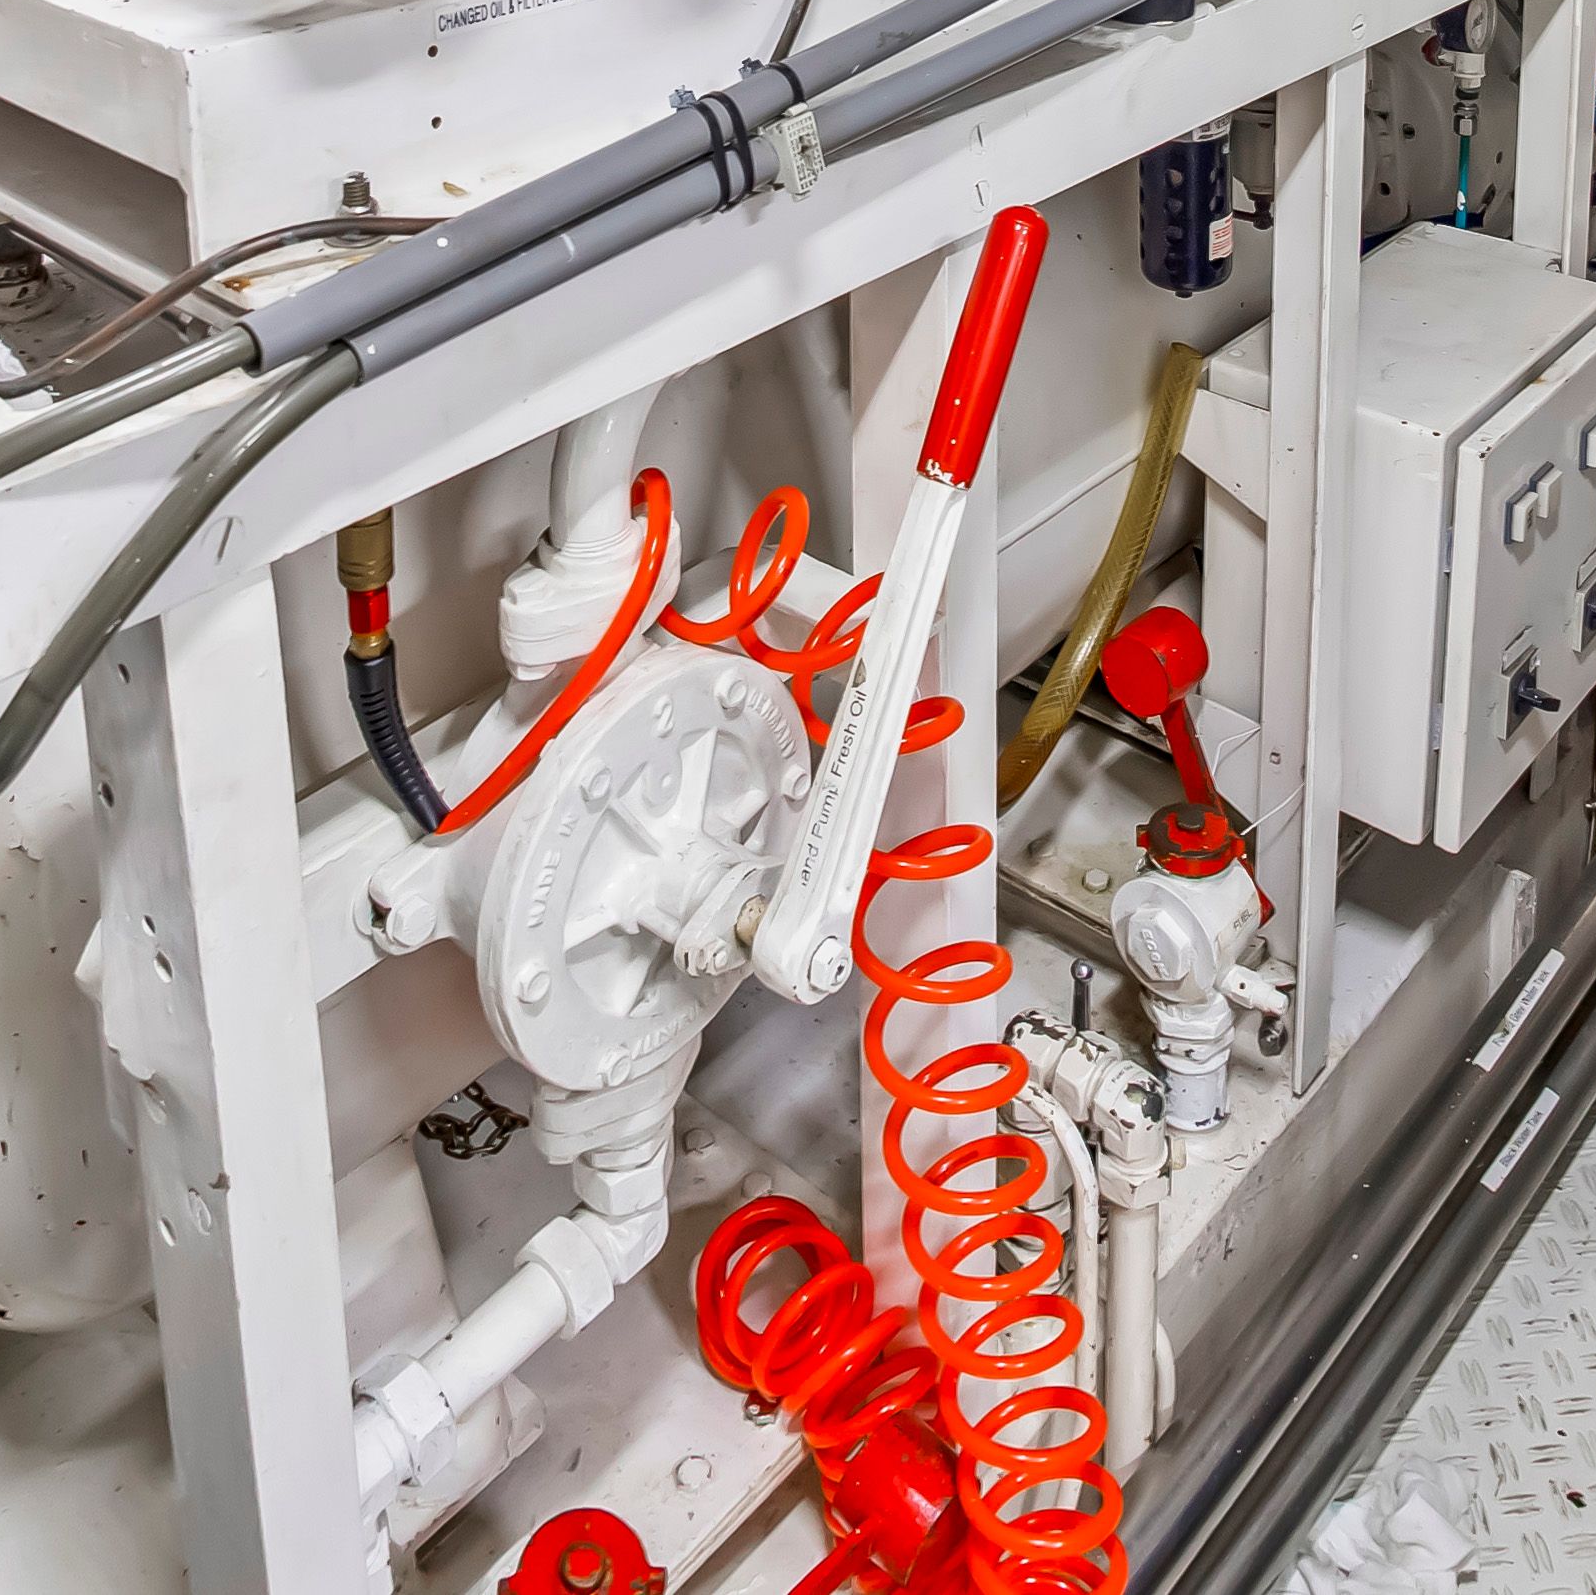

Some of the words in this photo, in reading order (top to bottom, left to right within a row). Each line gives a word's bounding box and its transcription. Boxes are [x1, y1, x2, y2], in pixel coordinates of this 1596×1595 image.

[438, 3, 490, 32] CHANGED
[490, 1, 507, 20] OIL
[801, 844, 820, 889] and
[830, 724, 859, 778] Fresh
[849, 689, 869, 719] Oil
